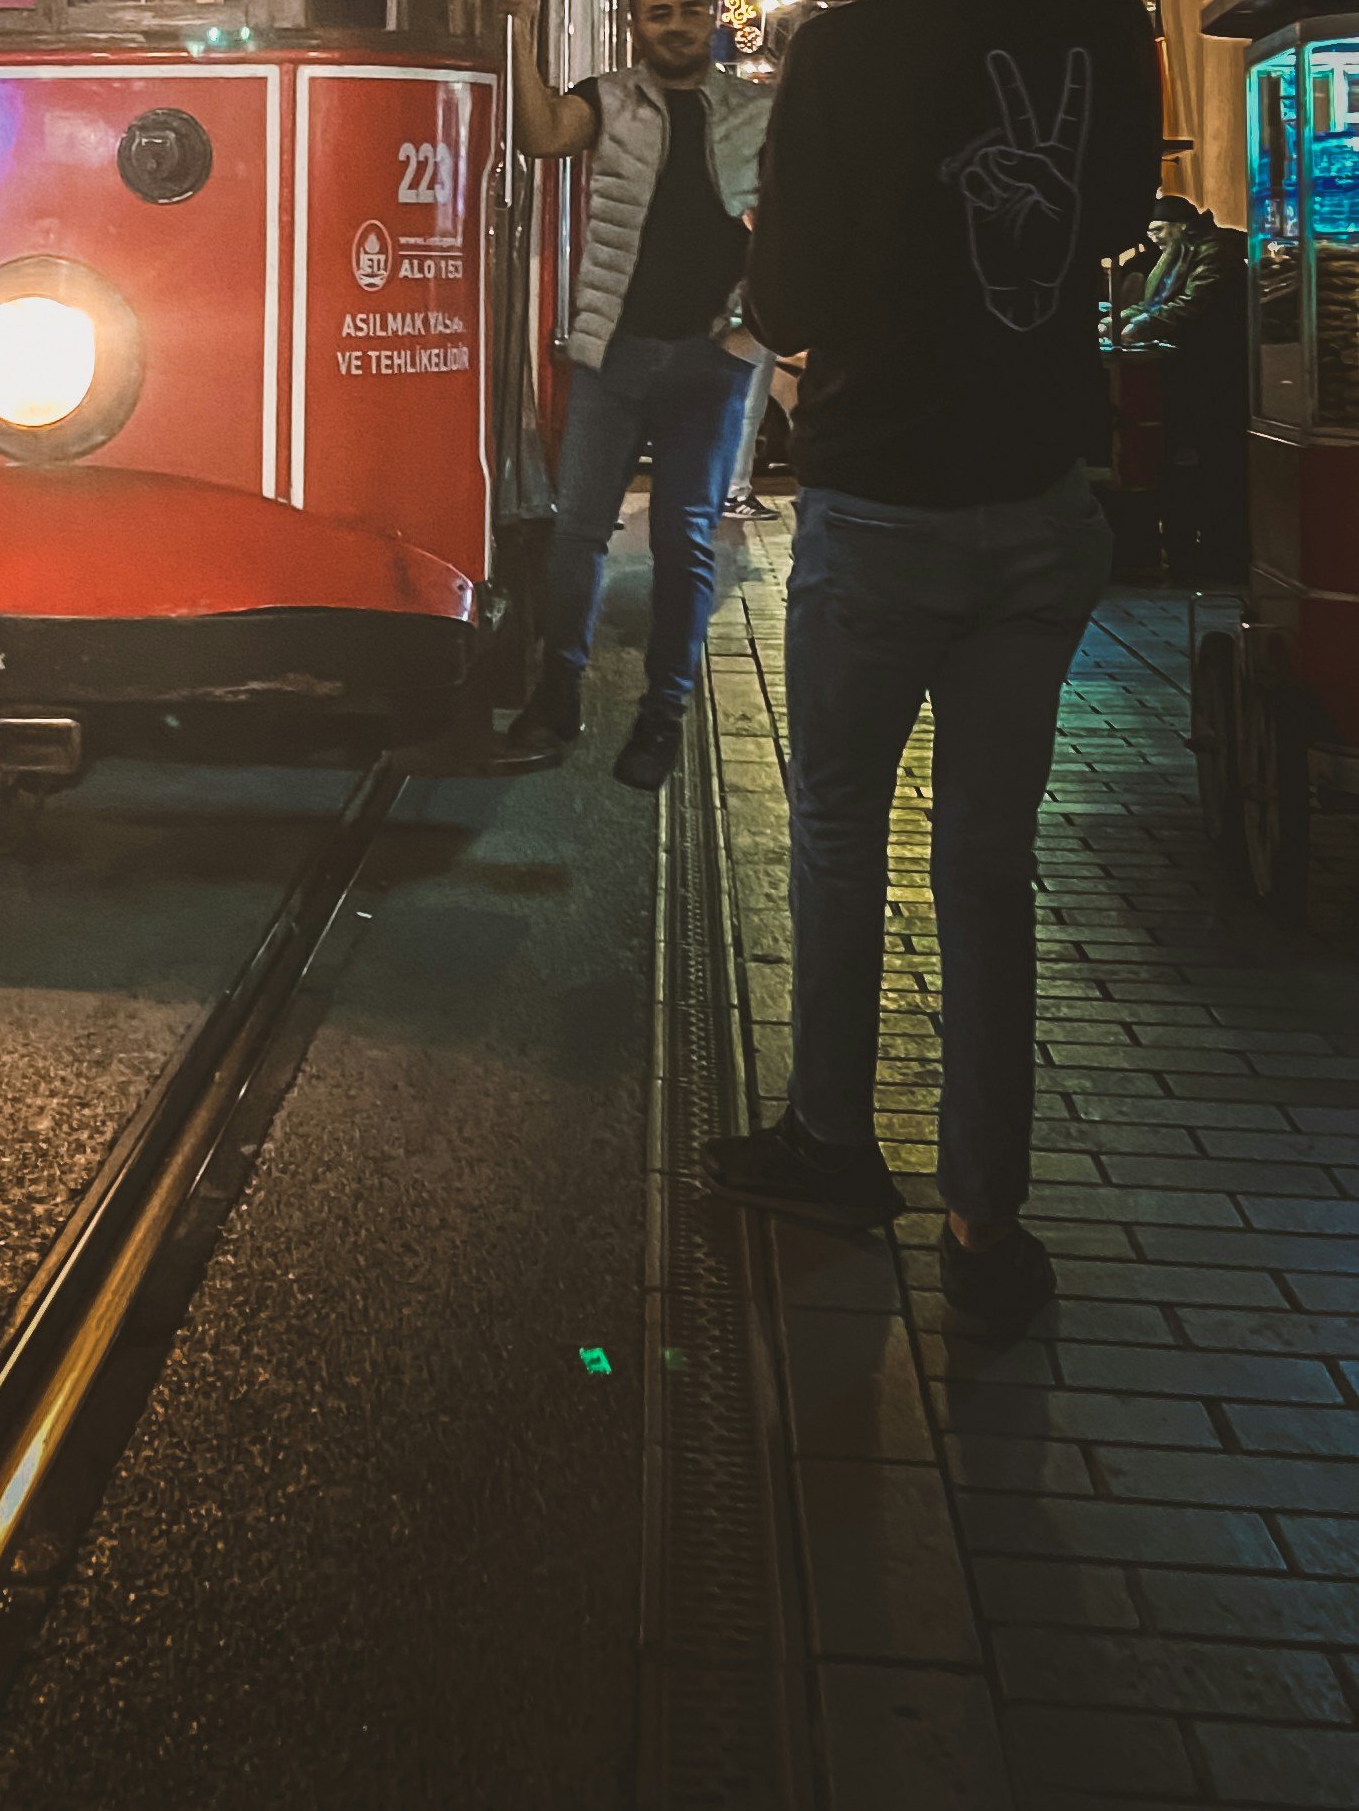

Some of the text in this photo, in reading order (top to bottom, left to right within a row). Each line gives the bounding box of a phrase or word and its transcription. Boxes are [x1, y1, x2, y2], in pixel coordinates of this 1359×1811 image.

[398, 142, 453, 203] 223
[398, 259, 435, 279] ALO
[342, 312, 426, 338] ASILMAK
[337, 350, 363, 375] VE
